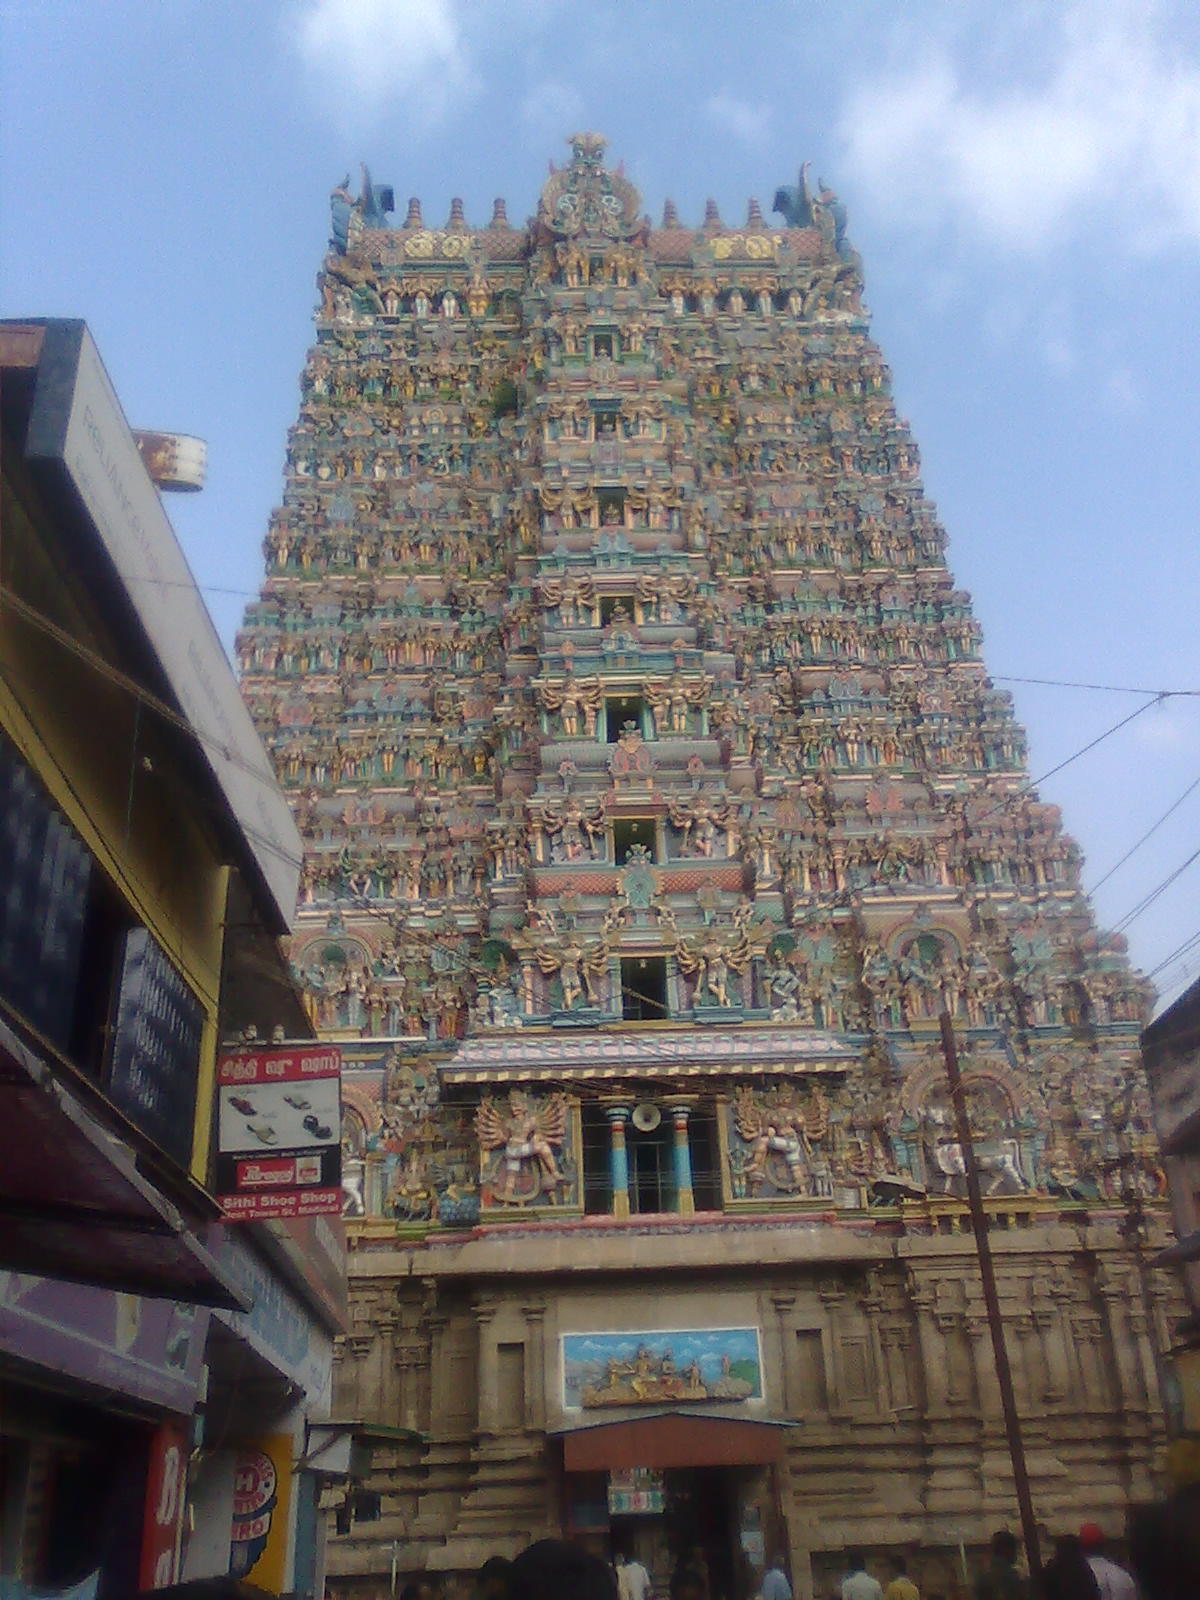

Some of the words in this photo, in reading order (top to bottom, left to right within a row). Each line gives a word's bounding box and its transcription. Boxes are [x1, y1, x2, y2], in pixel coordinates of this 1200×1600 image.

[223, 1197, 256, 1208] Sithi
[260, 1195, 296, 1207] Shoe
[300, 1193, 337, 1204] Shop
